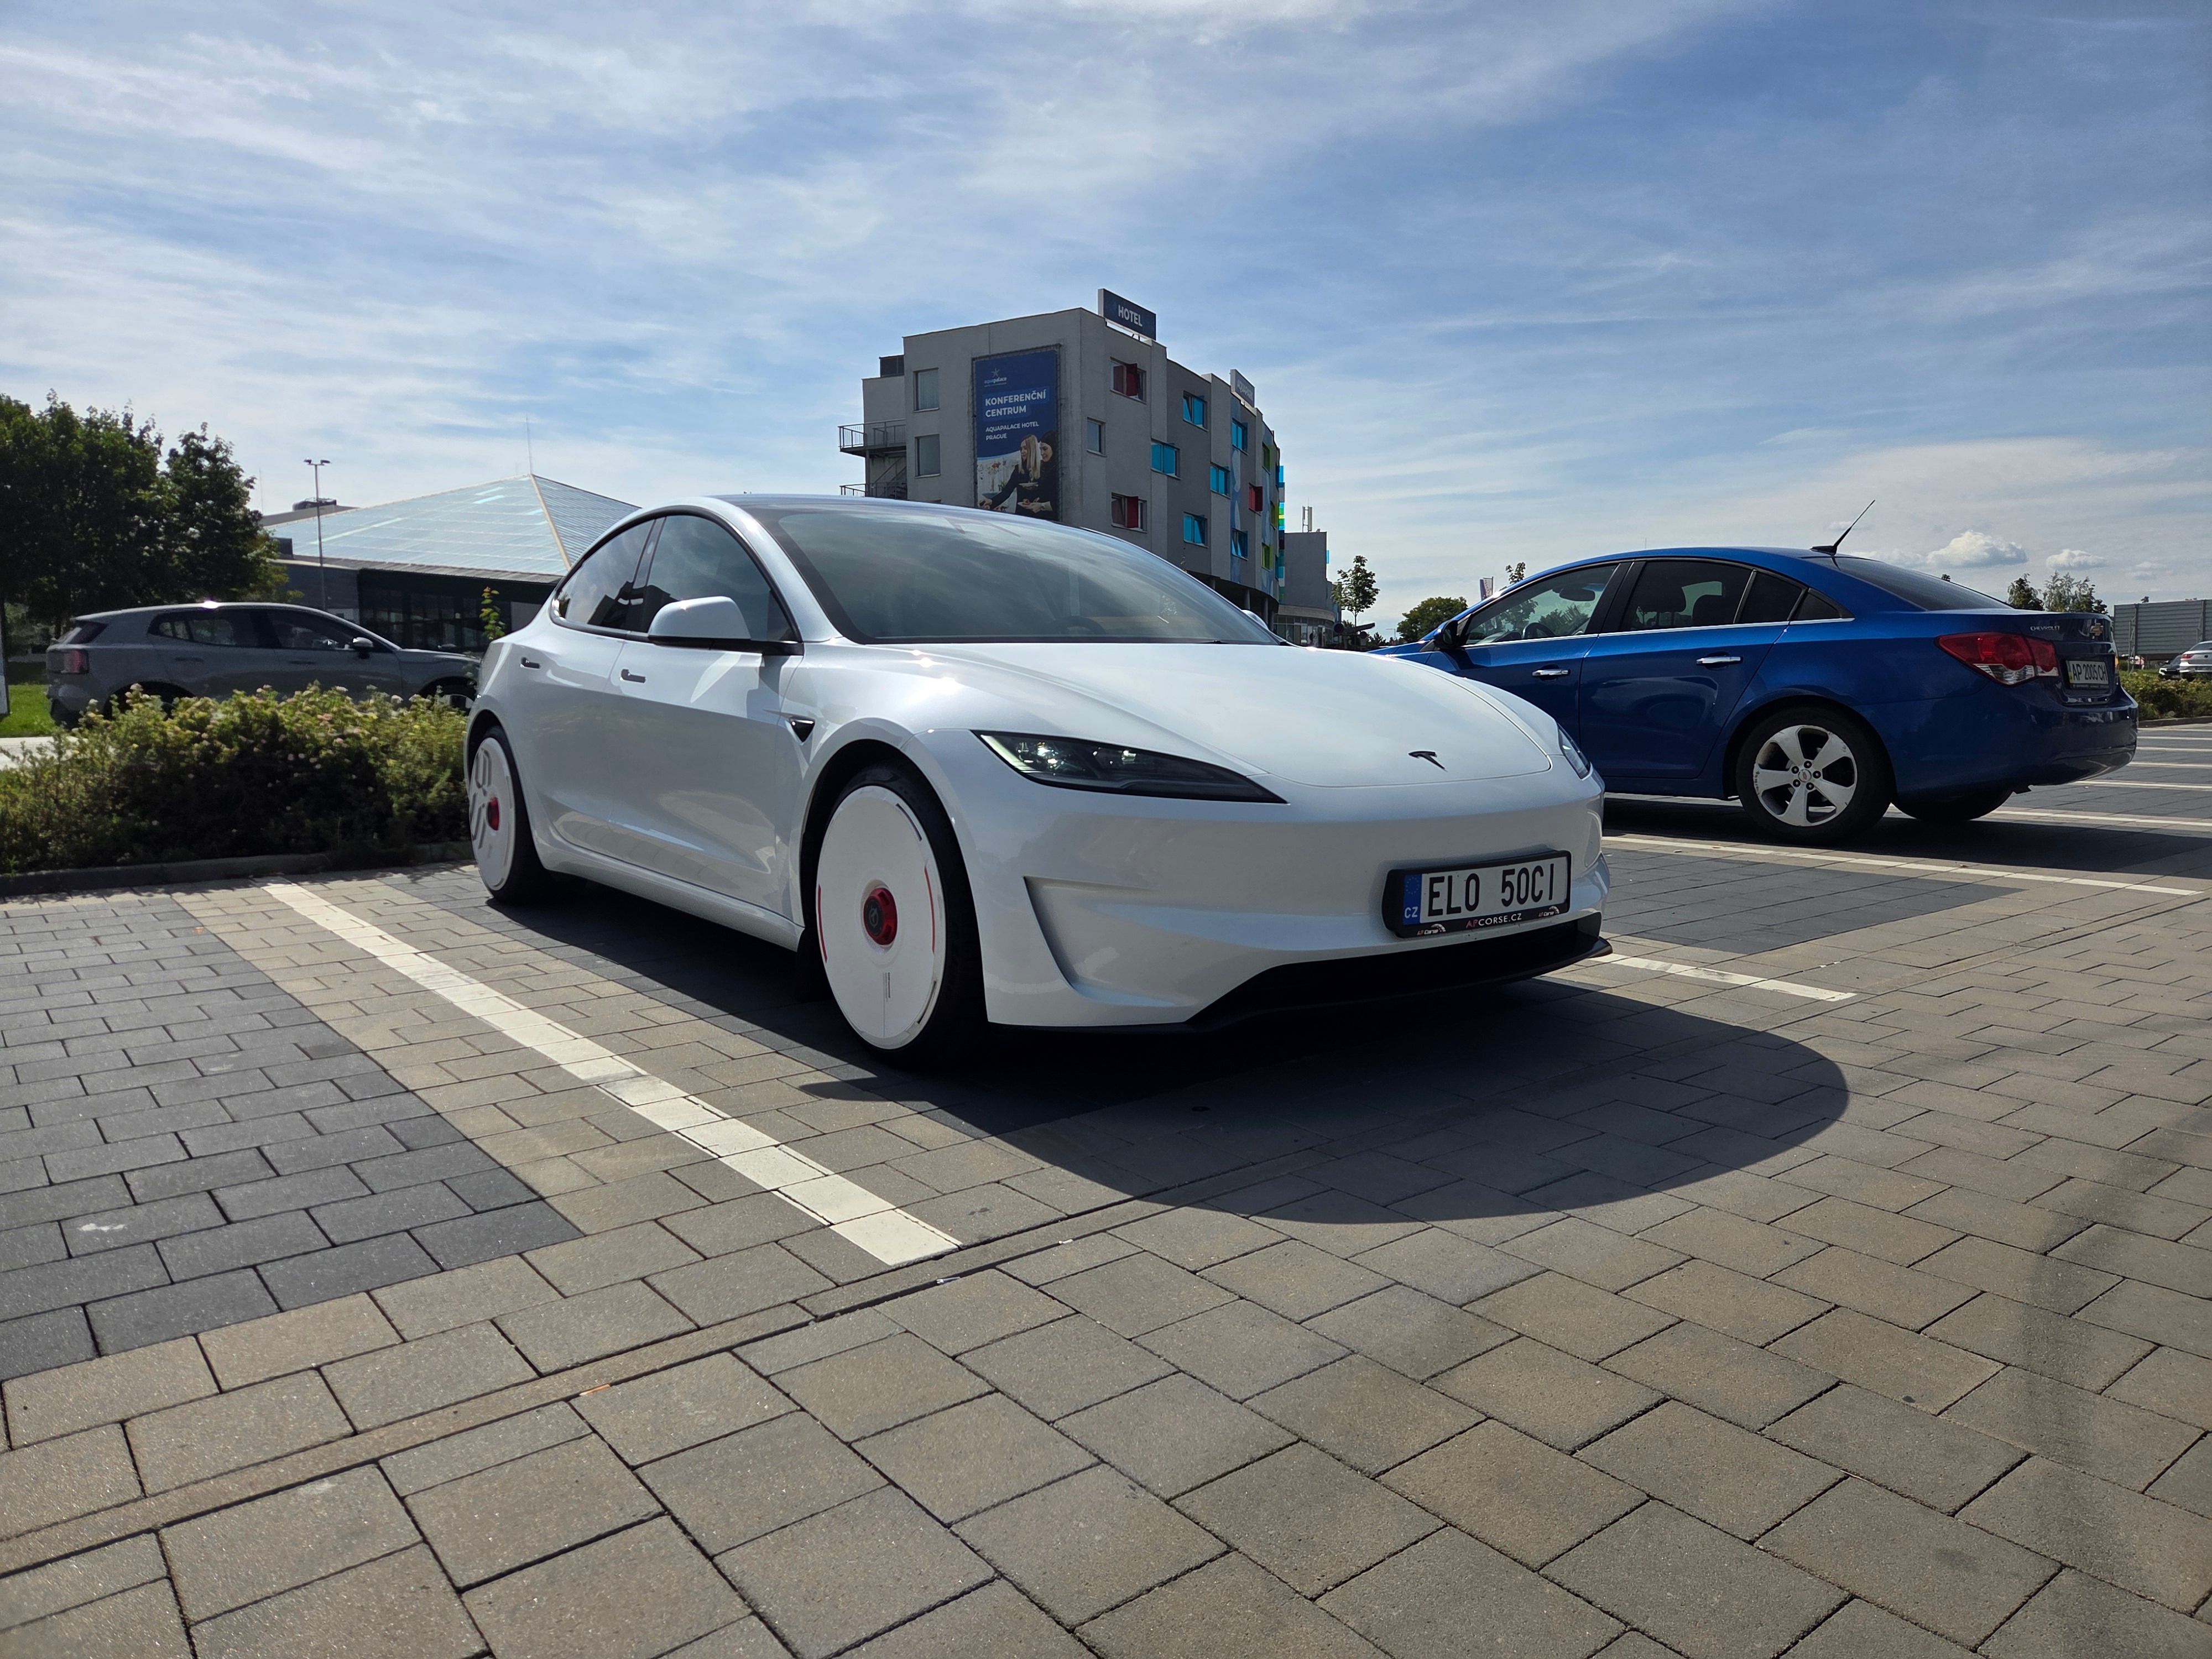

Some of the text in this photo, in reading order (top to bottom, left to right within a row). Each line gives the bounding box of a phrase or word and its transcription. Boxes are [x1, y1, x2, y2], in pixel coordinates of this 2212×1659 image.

[1118, 305, 1142, 327] HOTEL
[985, 389, 1046, 406] KONFERENČNÍ
[985, 405, 1026, 418] CENTRUM
[985, 423, 1021, 432] AQUAPALACE
[2072, 664, 2082, 681] AP
[1404, 906, 1418, 919] CZ
[1466, 912, 1522, 929] APCORSE.CZ
